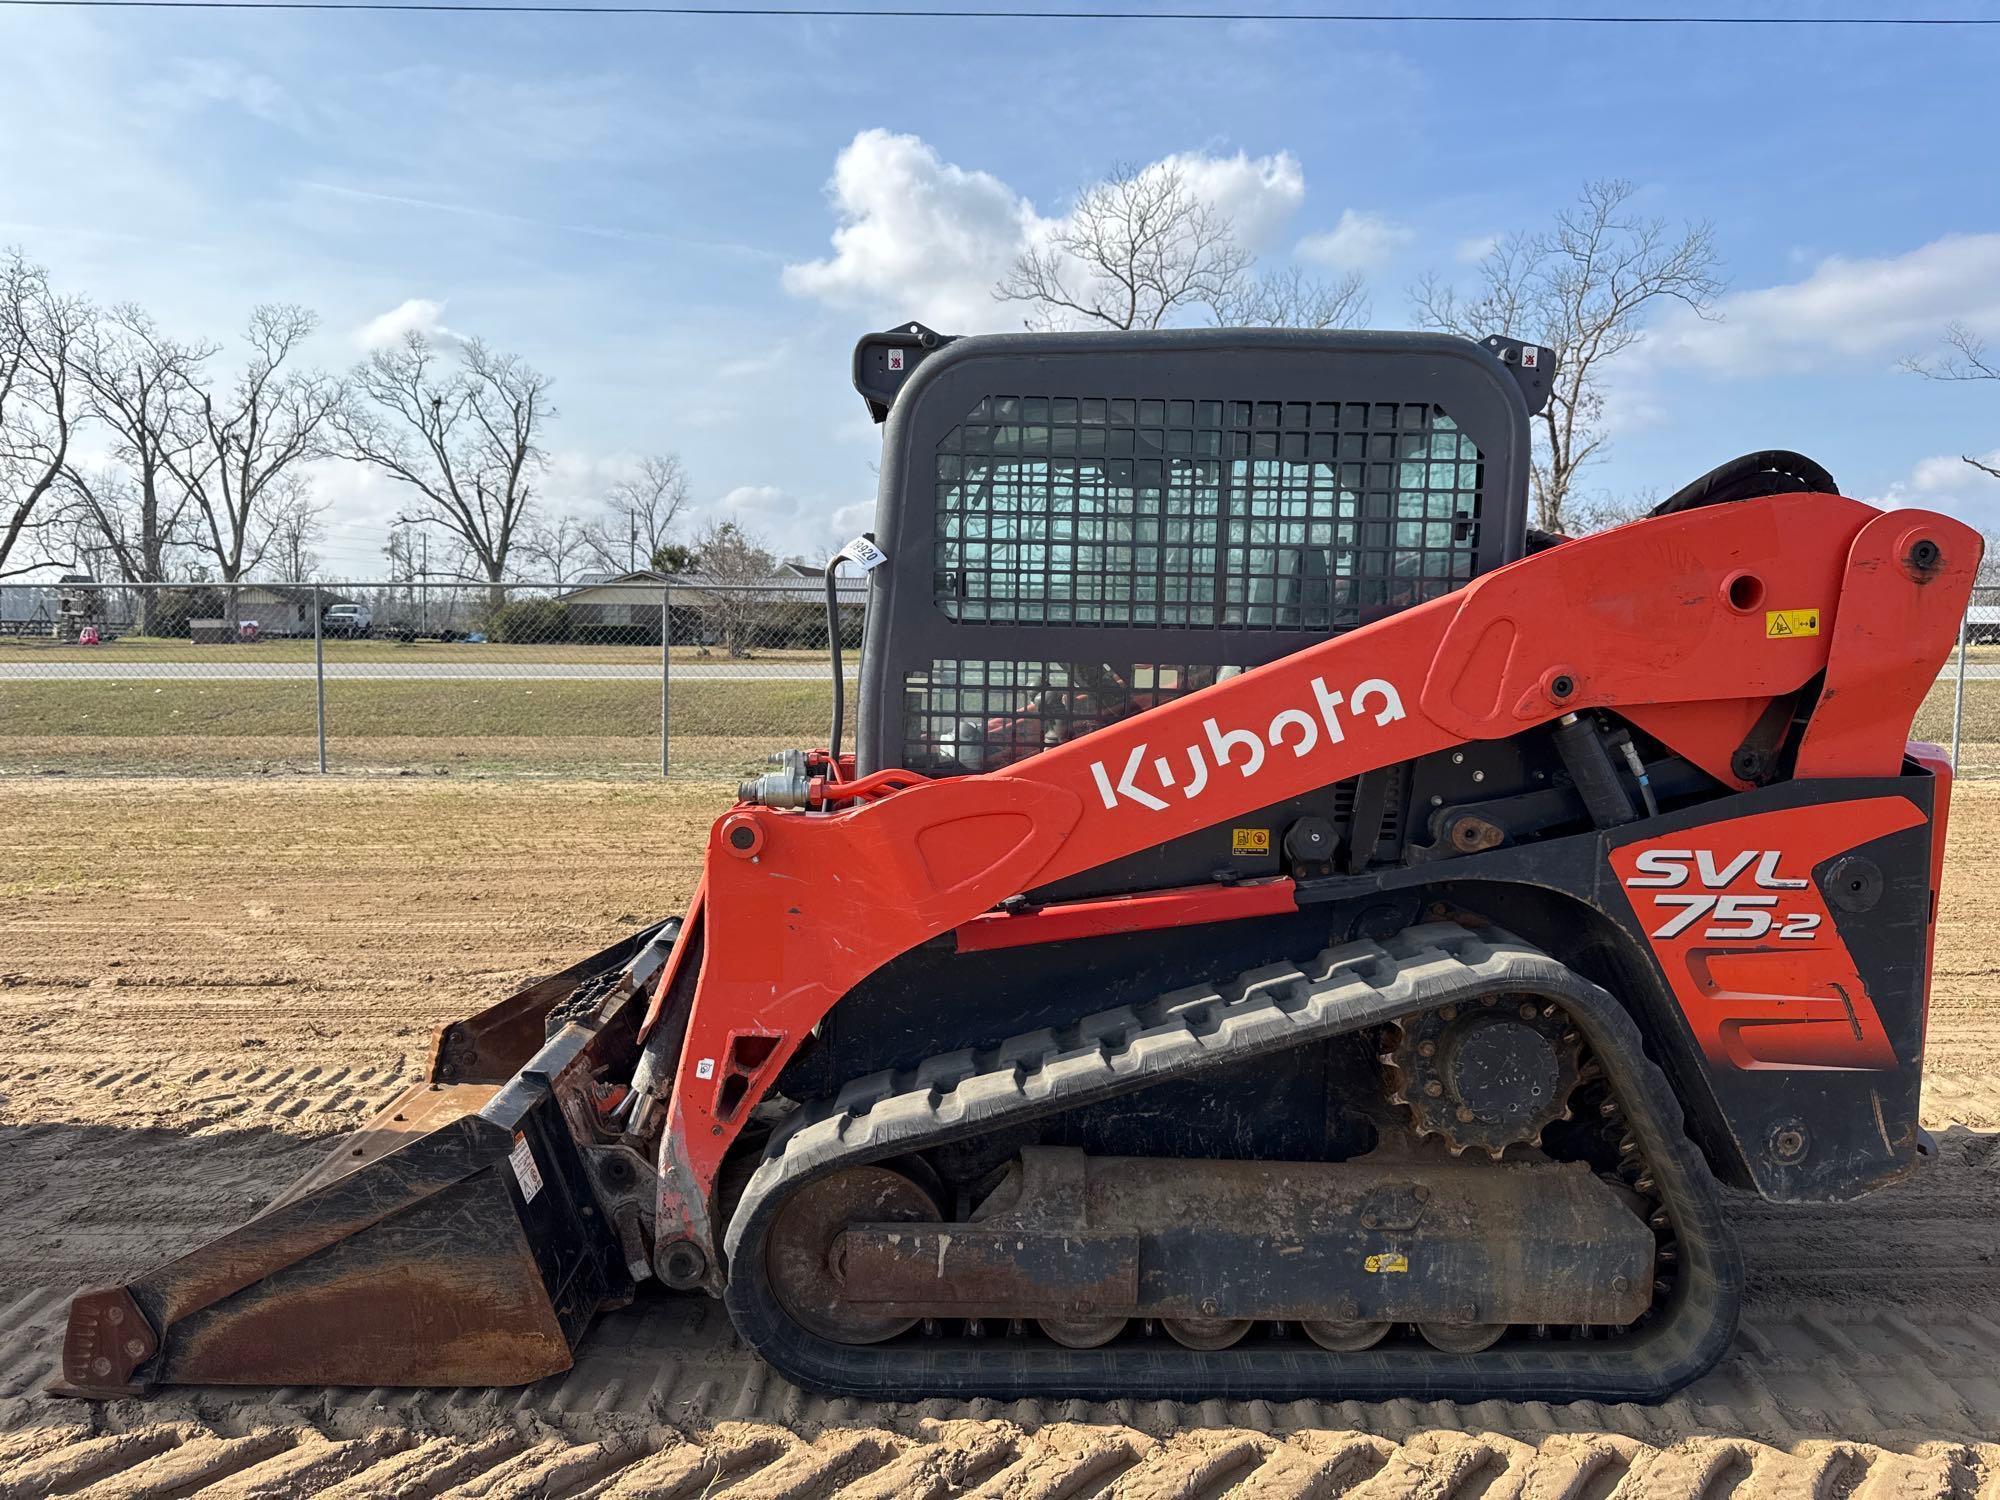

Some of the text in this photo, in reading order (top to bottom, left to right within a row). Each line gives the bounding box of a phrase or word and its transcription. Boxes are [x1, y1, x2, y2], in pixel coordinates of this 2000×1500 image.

[1089, 676, 1407, 811] Kubota
[1625, 850, 1809, 890] SVL
[1650, 894, 1822, 940] 75-2
